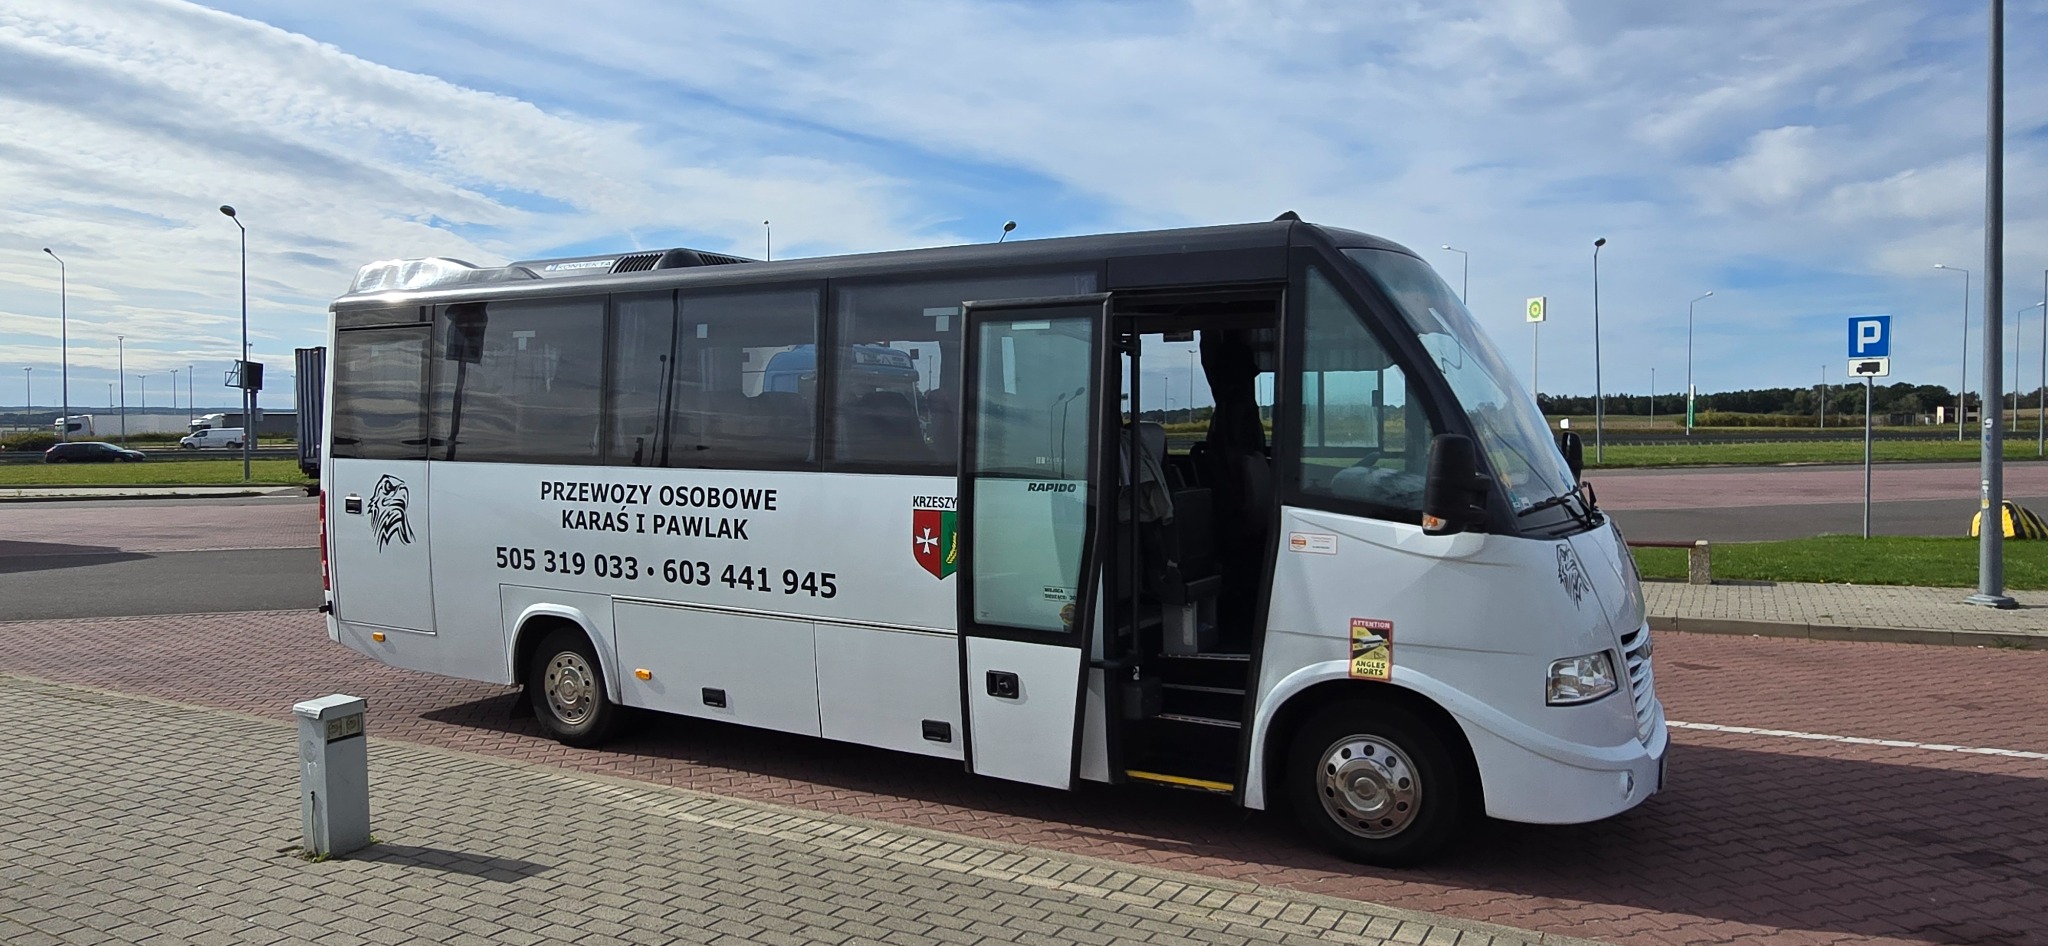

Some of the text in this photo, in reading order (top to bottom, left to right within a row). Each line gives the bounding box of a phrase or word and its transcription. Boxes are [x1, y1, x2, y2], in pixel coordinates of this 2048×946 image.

[1857, 320, 1881, 353] P
[541, 481, 777, 511] PRZEWOZY OSOBOWE
[1028, 483, 1076, 492] RAPIDO
[562, 506, 748, 540] KARAŚ I PAWLAK
[496, 546, 536, 571] 505
[544, 550, 586, 575] 319
[594, 554, 638, 580] 033
[663, 559, 711, 586] 603
[721, 564, 771, 592] 441
[782, 569, 837, 598] 945
[1353, 620, 1390, 628] ATTENTION
[1356, 660, 1386, 669] ANGLES
[1356, 668, 1384, 676] MORTS
